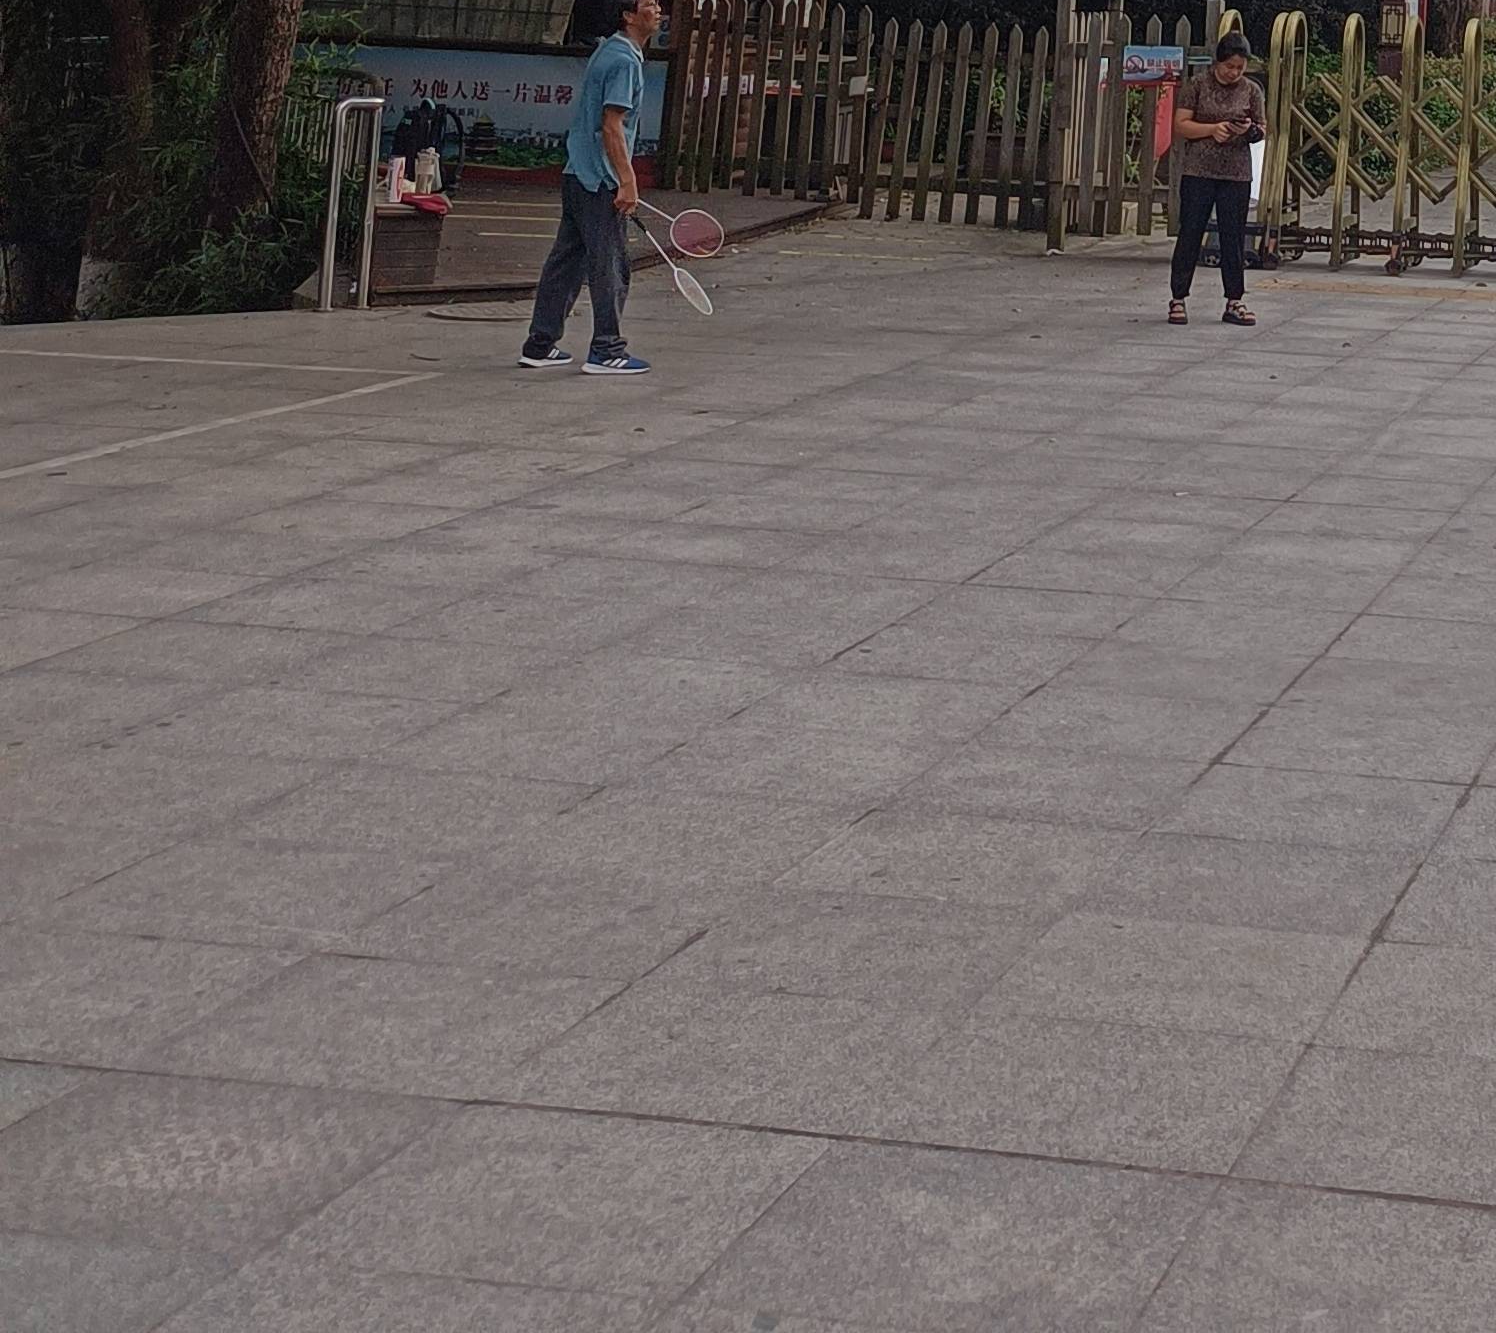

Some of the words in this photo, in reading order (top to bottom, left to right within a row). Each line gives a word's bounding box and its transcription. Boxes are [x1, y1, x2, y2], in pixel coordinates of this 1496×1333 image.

[409, 78, 575, 106] 为他人送一片温馨
